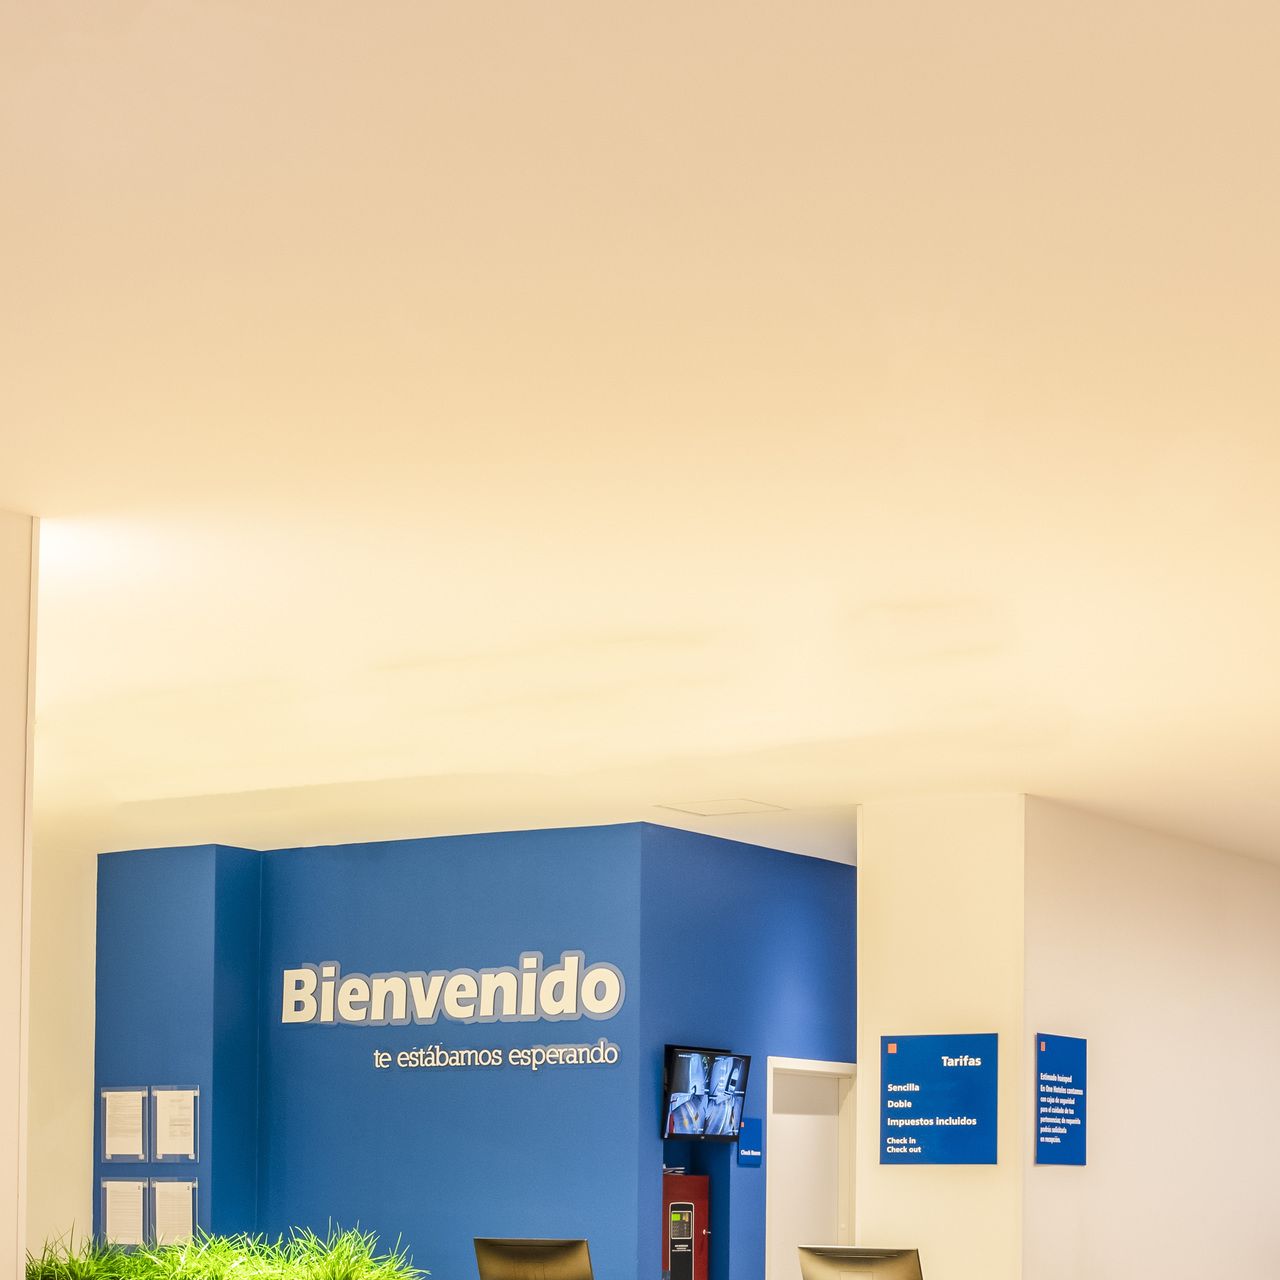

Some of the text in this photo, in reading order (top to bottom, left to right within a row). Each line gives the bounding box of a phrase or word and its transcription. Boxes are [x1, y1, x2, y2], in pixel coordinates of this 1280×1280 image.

[281, 956, 619, 1024] Bienvenido
[373, 1041, 618, 1070] te estábamos esperando
[941, 1055, 982, 1067] Tarifas
[887, 1083, 920, 1092] Sencilla
[887, 1100, 912, 1108] Doble
[887, 1116, 977, 1128] Impuestos incluidos
[886, 1137, 916, 1145] Check in
[886, 1145, 908, 1153] Check
